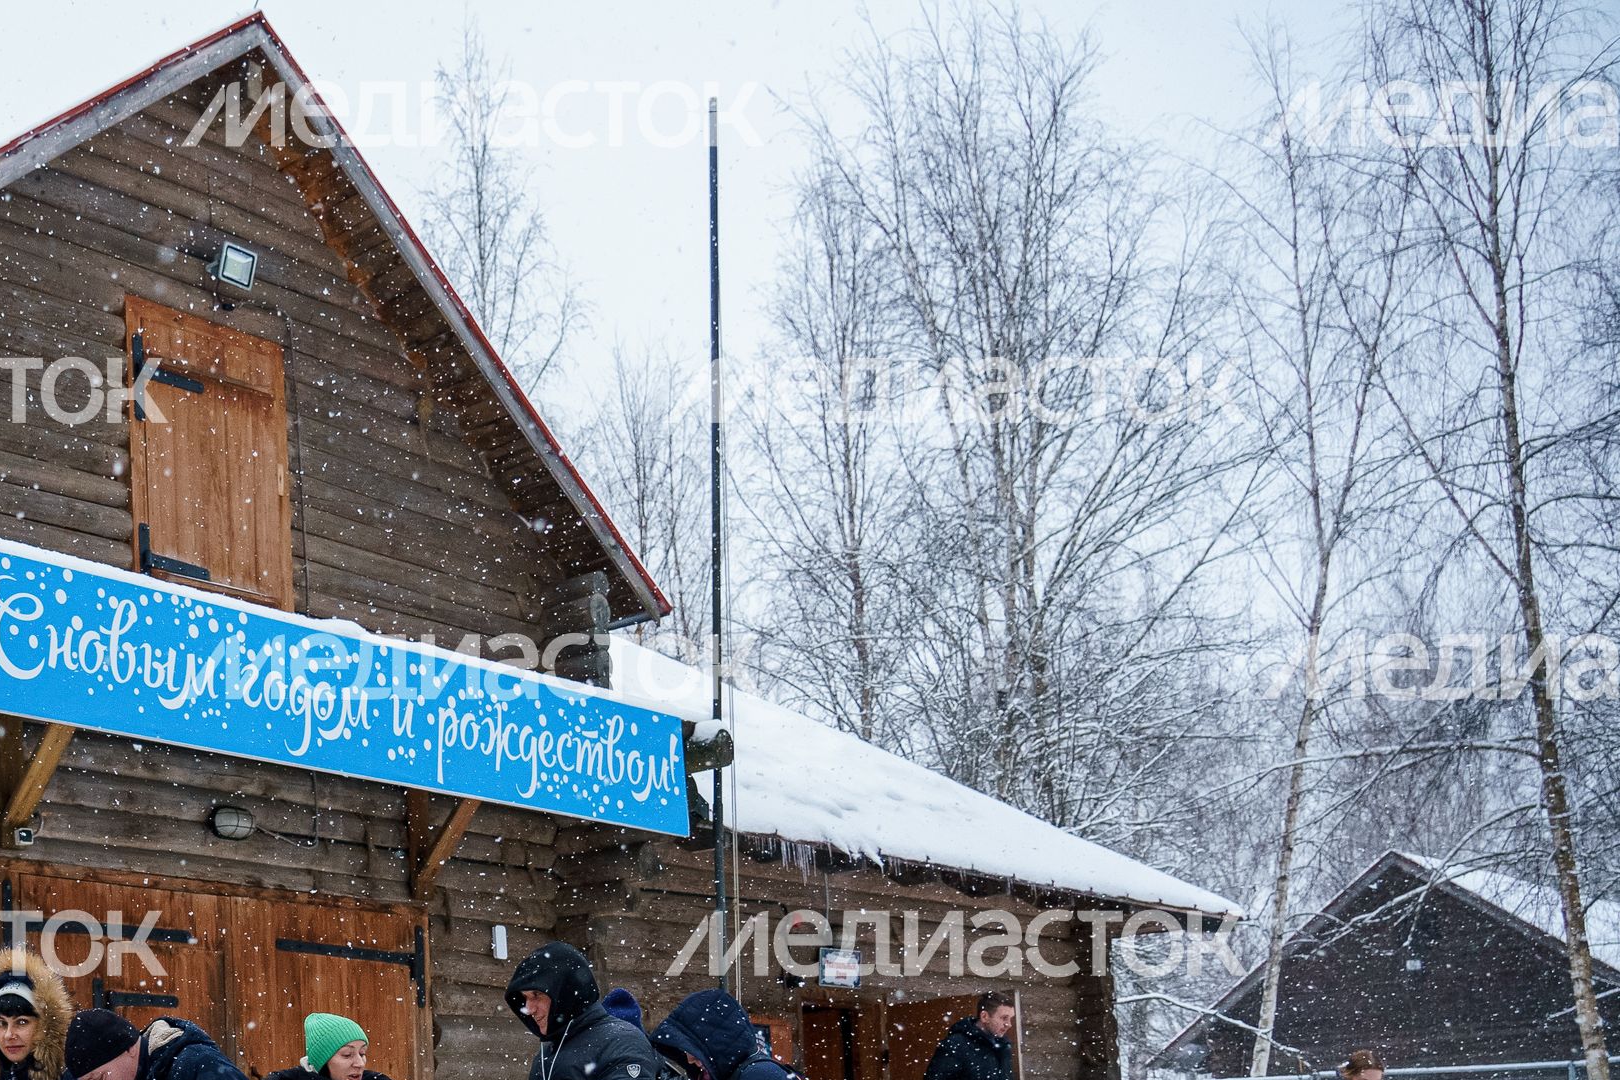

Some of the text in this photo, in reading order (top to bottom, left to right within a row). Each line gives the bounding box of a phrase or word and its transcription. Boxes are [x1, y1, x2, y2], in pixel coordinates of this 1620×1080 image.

[241, 664, 371, 757] годом
[389, 694, 415, 739] и
[437, 703, 679, 801] рождеством!
